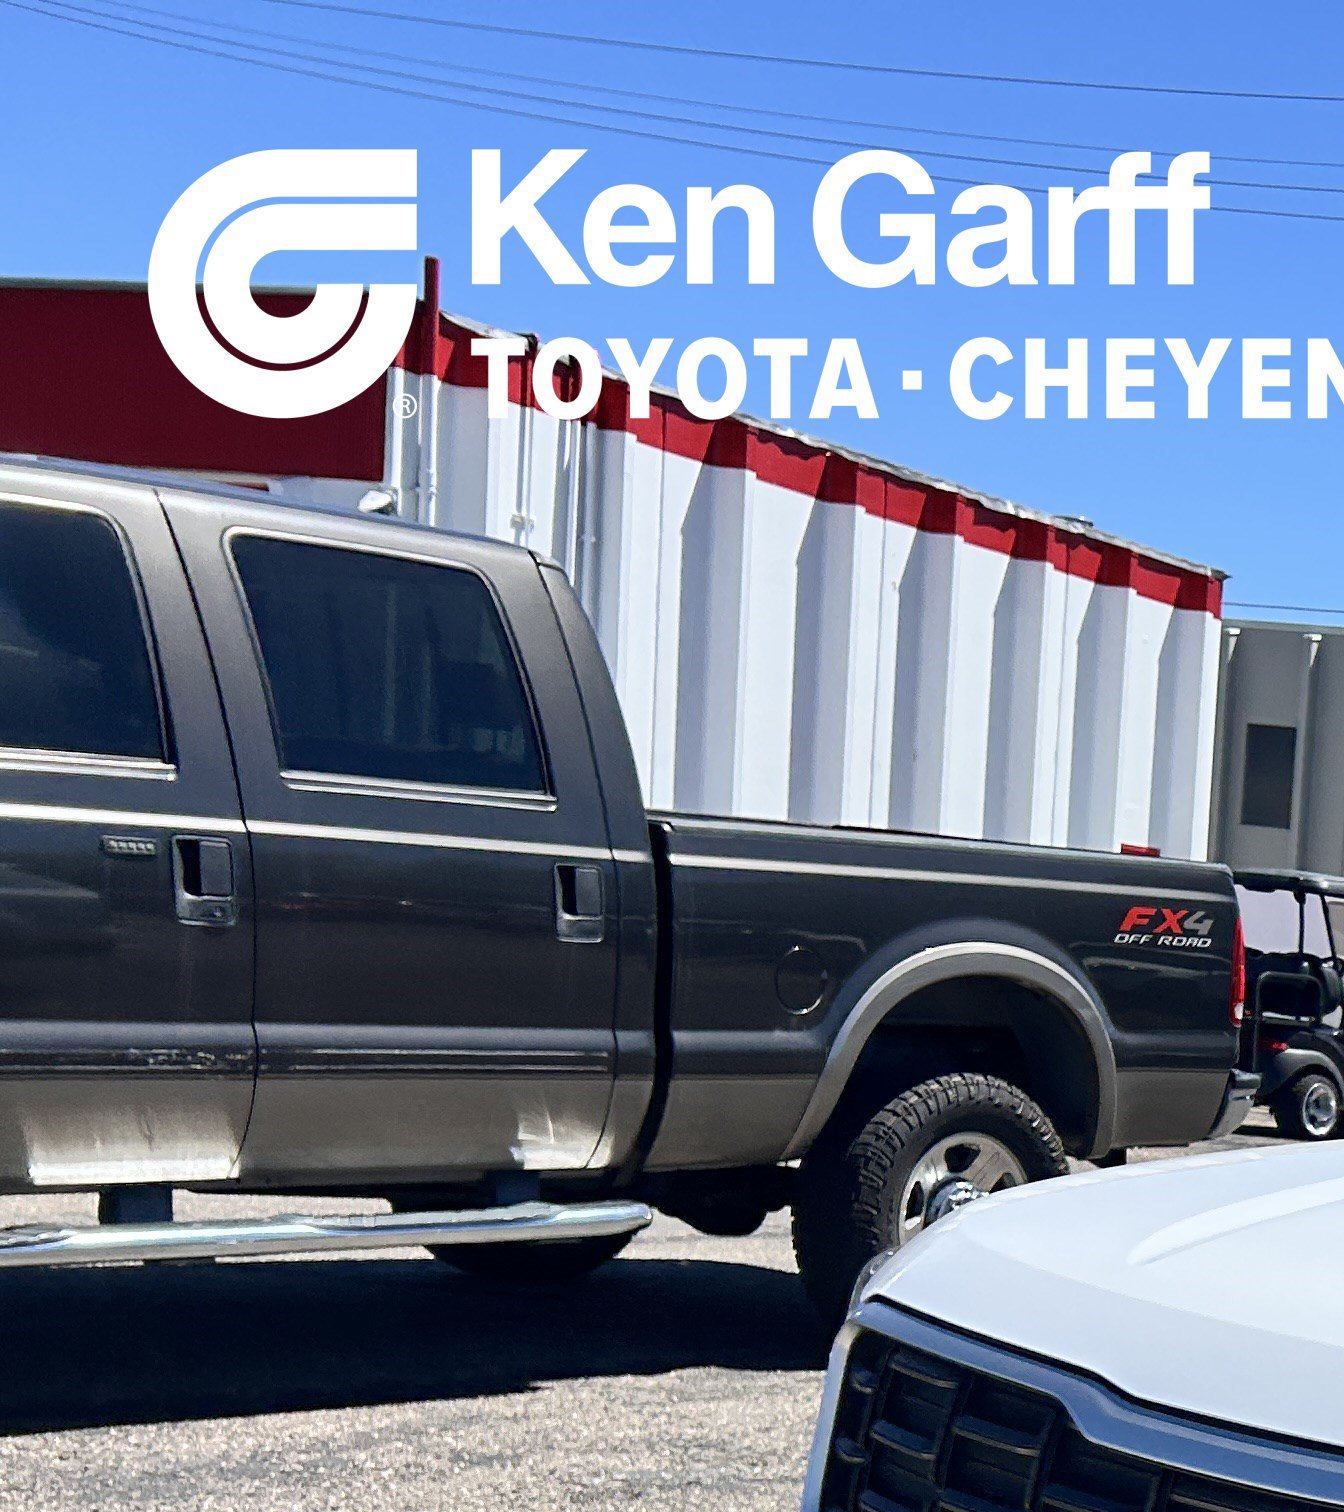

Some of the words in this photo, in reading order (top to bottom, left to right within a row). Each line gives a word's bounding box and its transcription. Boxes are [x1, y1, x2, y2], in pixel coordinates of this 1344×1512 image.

[1119, 905, 1214, 935] FX4
[1113, 933, 1153, 945] OFF
[1157, 935, 1212, 948] ROAD
